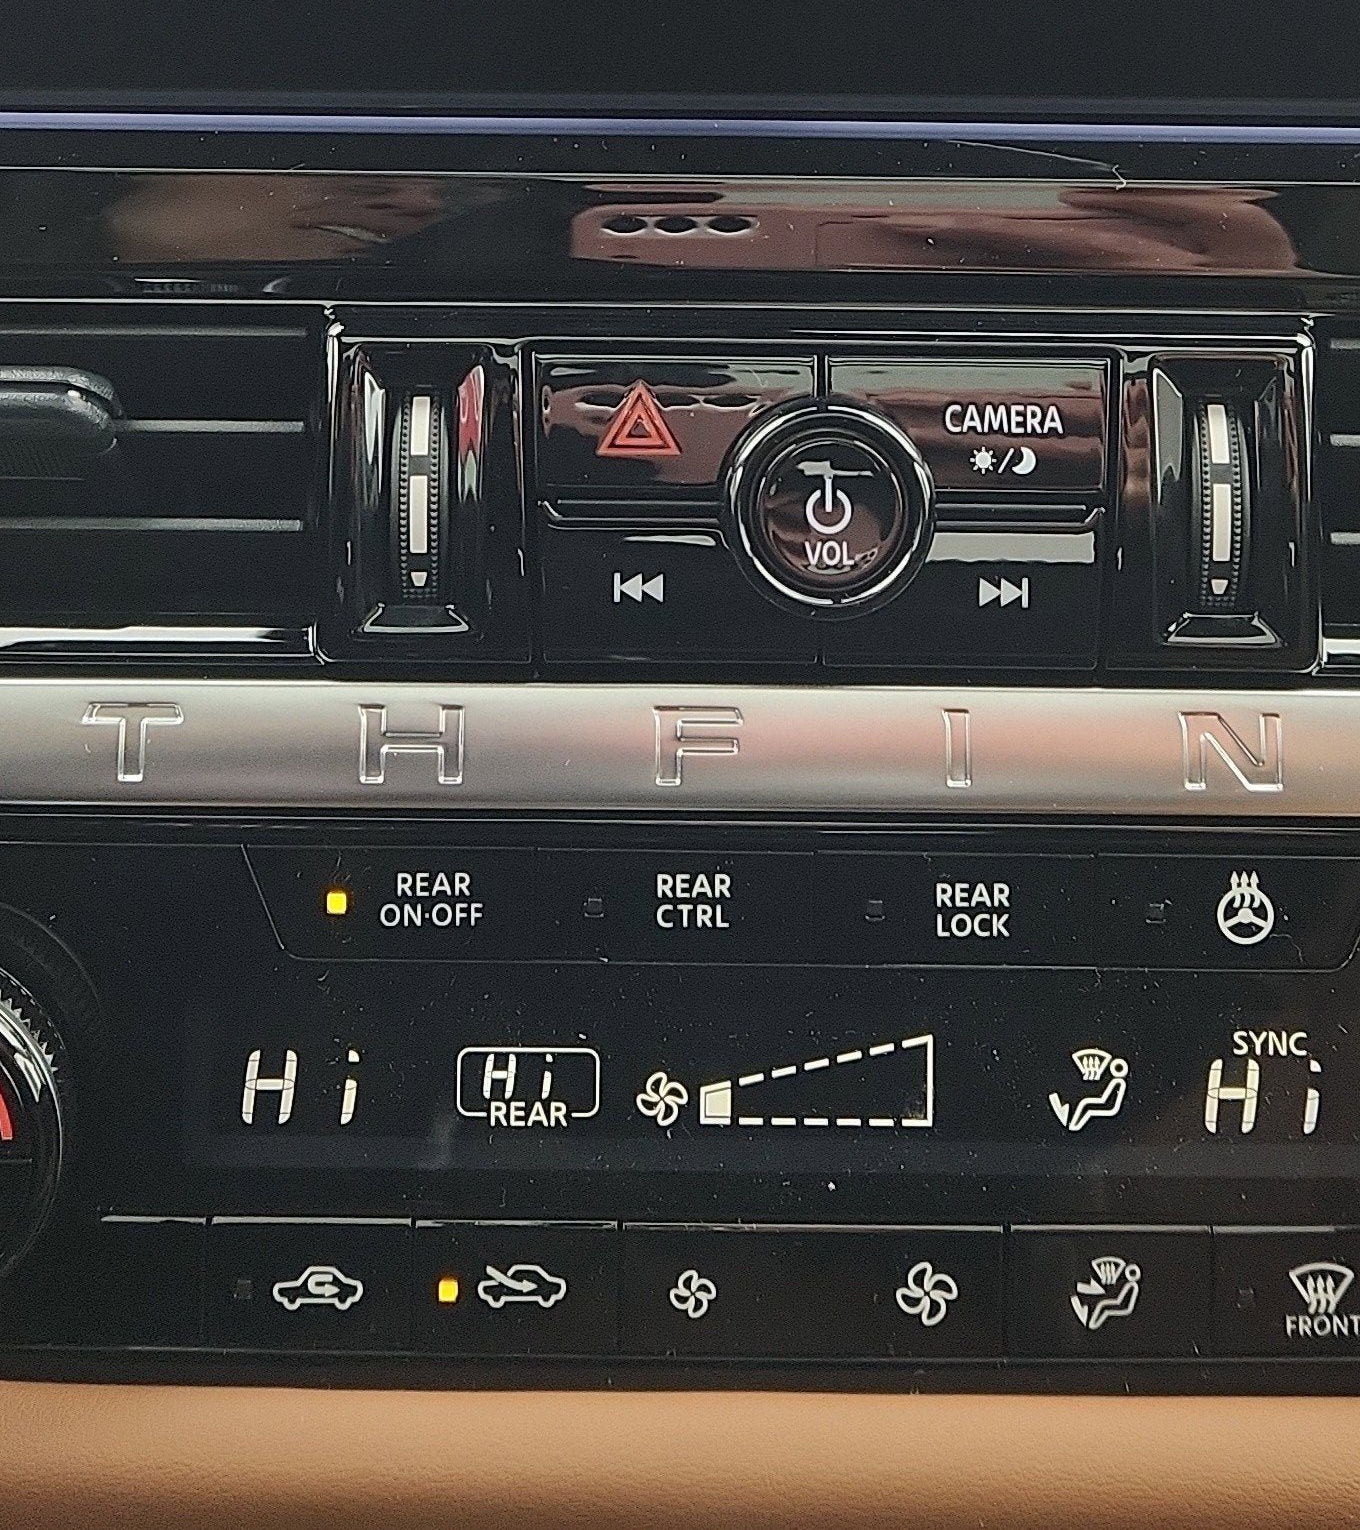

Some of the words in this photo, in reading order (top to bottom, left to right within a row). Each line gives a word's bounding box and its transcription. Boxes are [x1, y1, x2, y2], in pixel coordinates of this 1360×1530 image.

[943, 401, 1064, 437] CAMERA
[804, 539, 855, 566] VOL
[397, 872, 471, 897] REAR
[656, 873, 731, 899] REAR
[936, 882, 1010, 908] REAR
[656, 904, 730, 928] CTRL
[936, 913, 1010, 938] LOCK
[1233, 1030, 1308, 1057] SYNC
[490, 1101, 568, 1127] REAR
